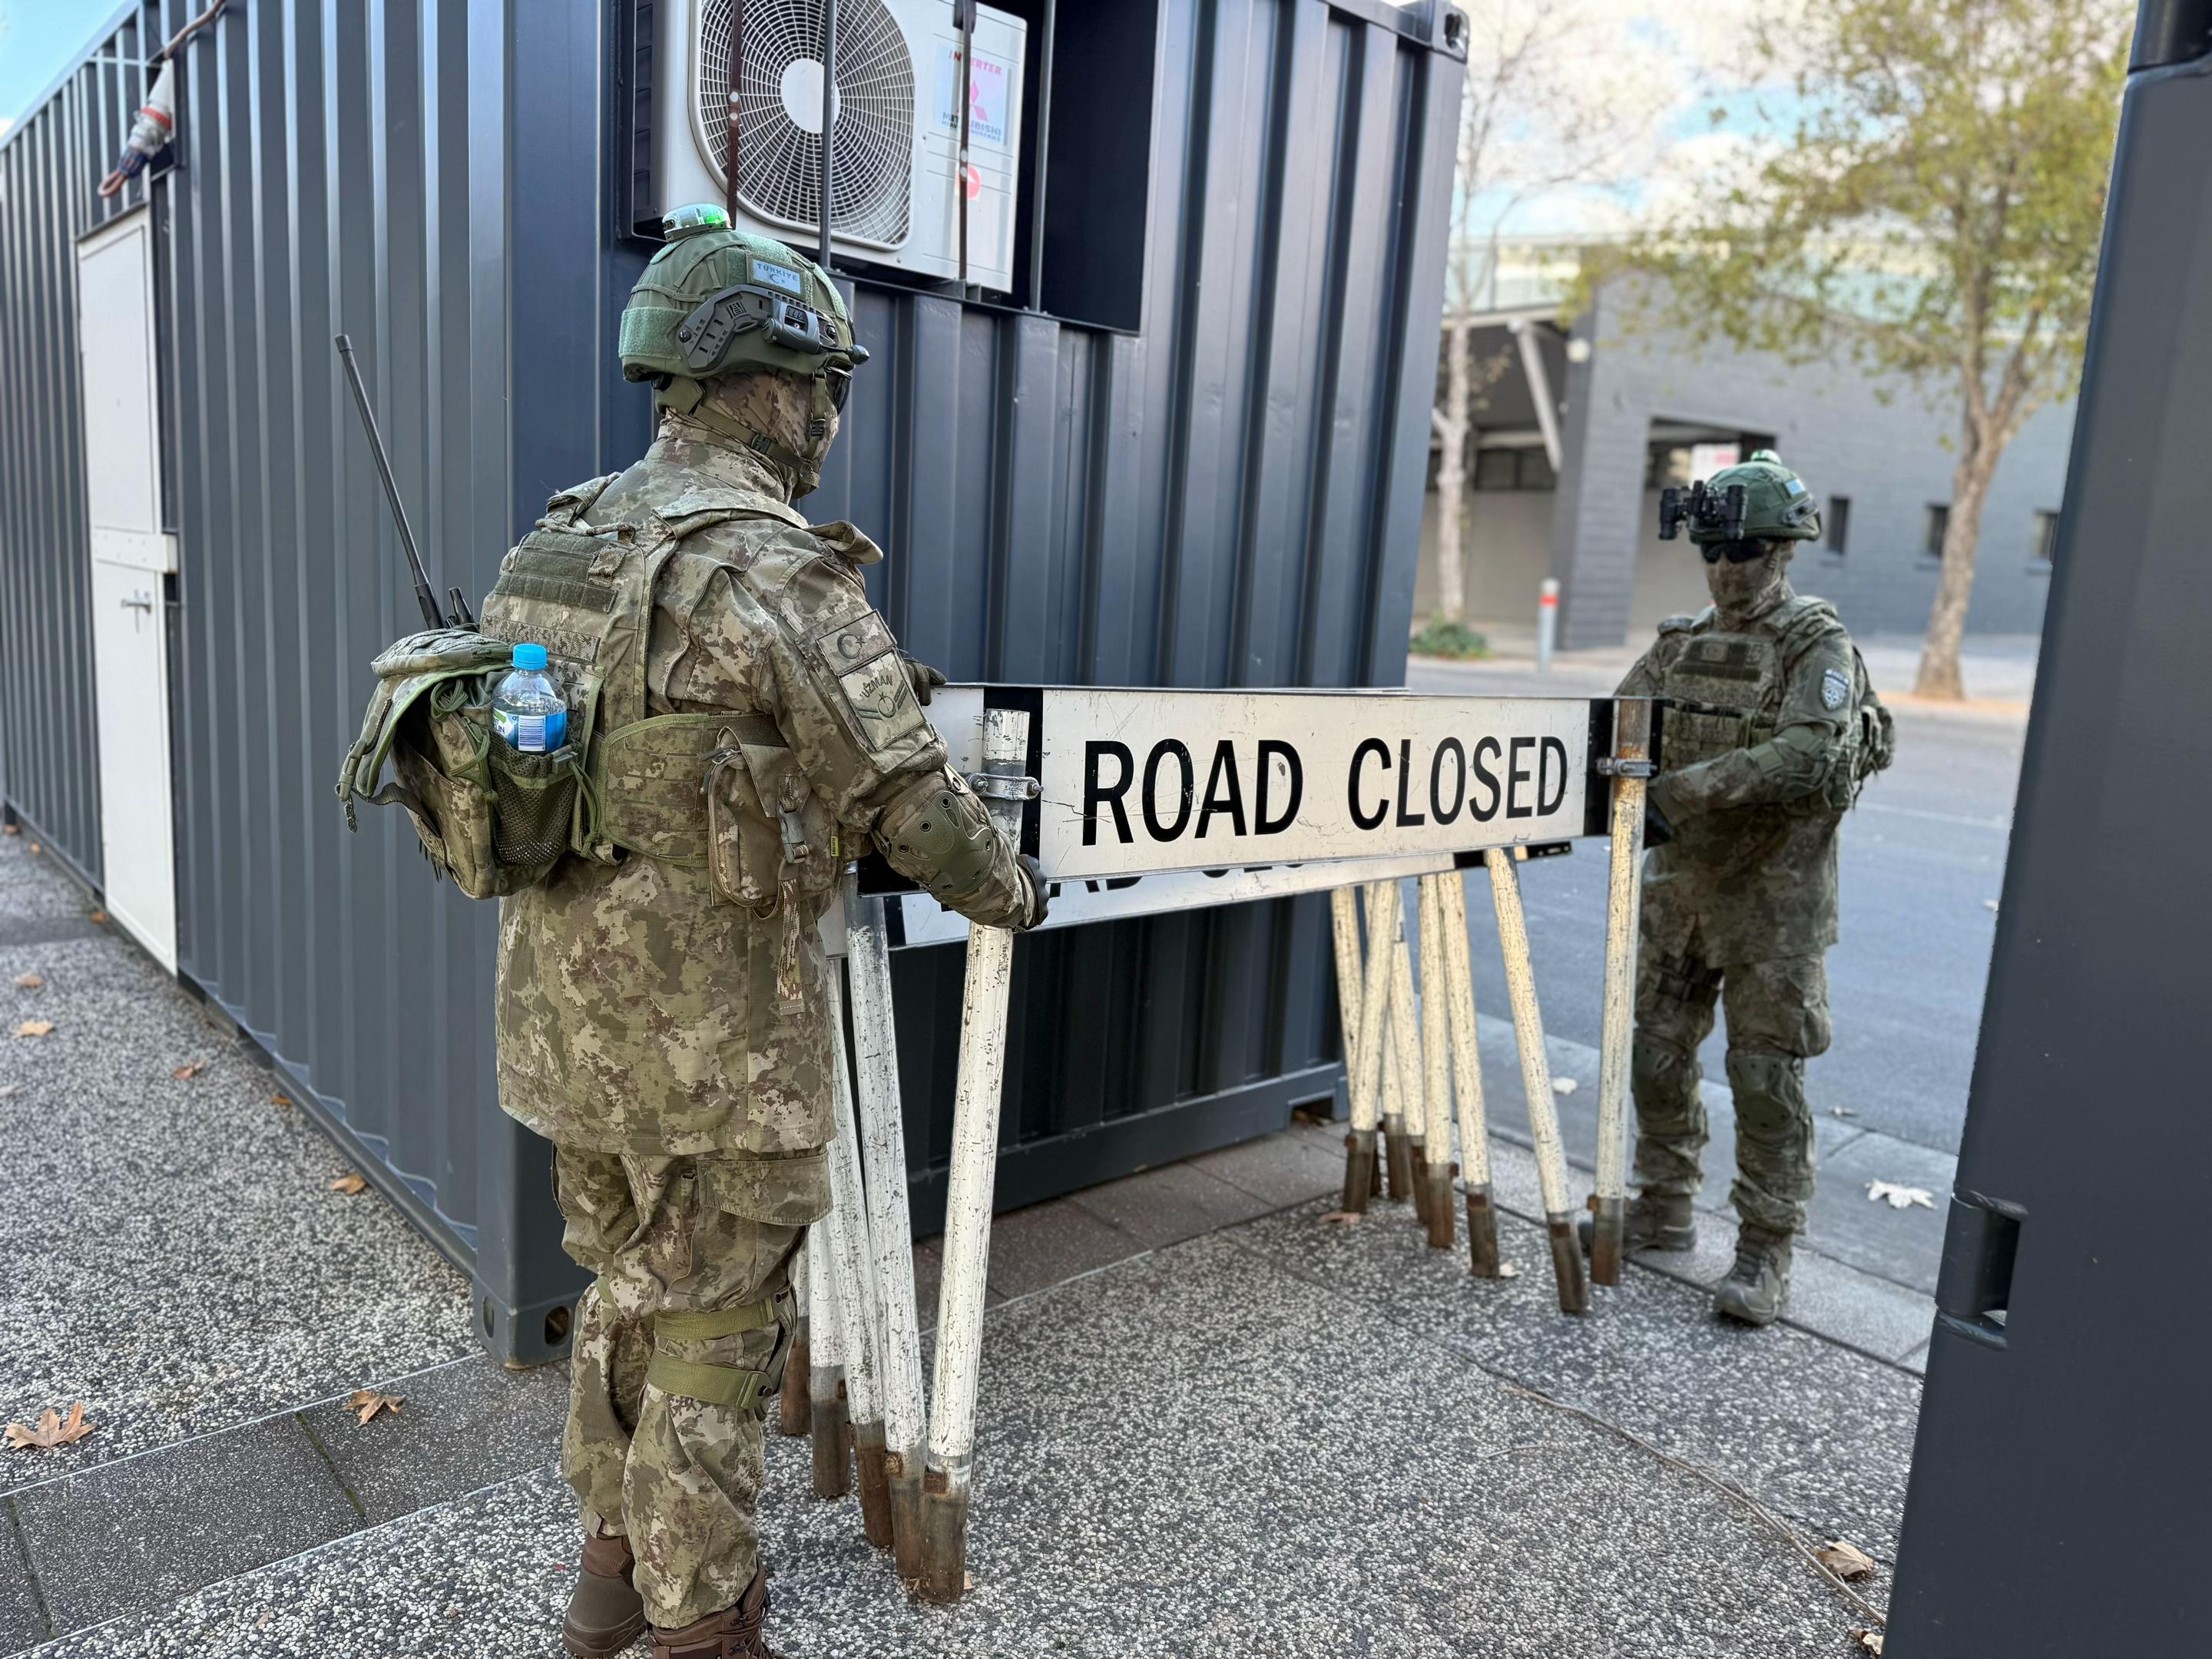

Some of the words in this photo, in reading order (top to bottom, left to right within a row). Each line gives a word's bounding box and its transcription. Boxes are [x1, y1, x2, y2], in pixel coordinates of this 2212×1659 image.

[949, 50, 1002, 75] INERTER
[942, 111, 1002, 136] MITBISHI
[1081, 738, 1303, 846] ROAD
[1348, 736, 1568, 830] CLOSED
